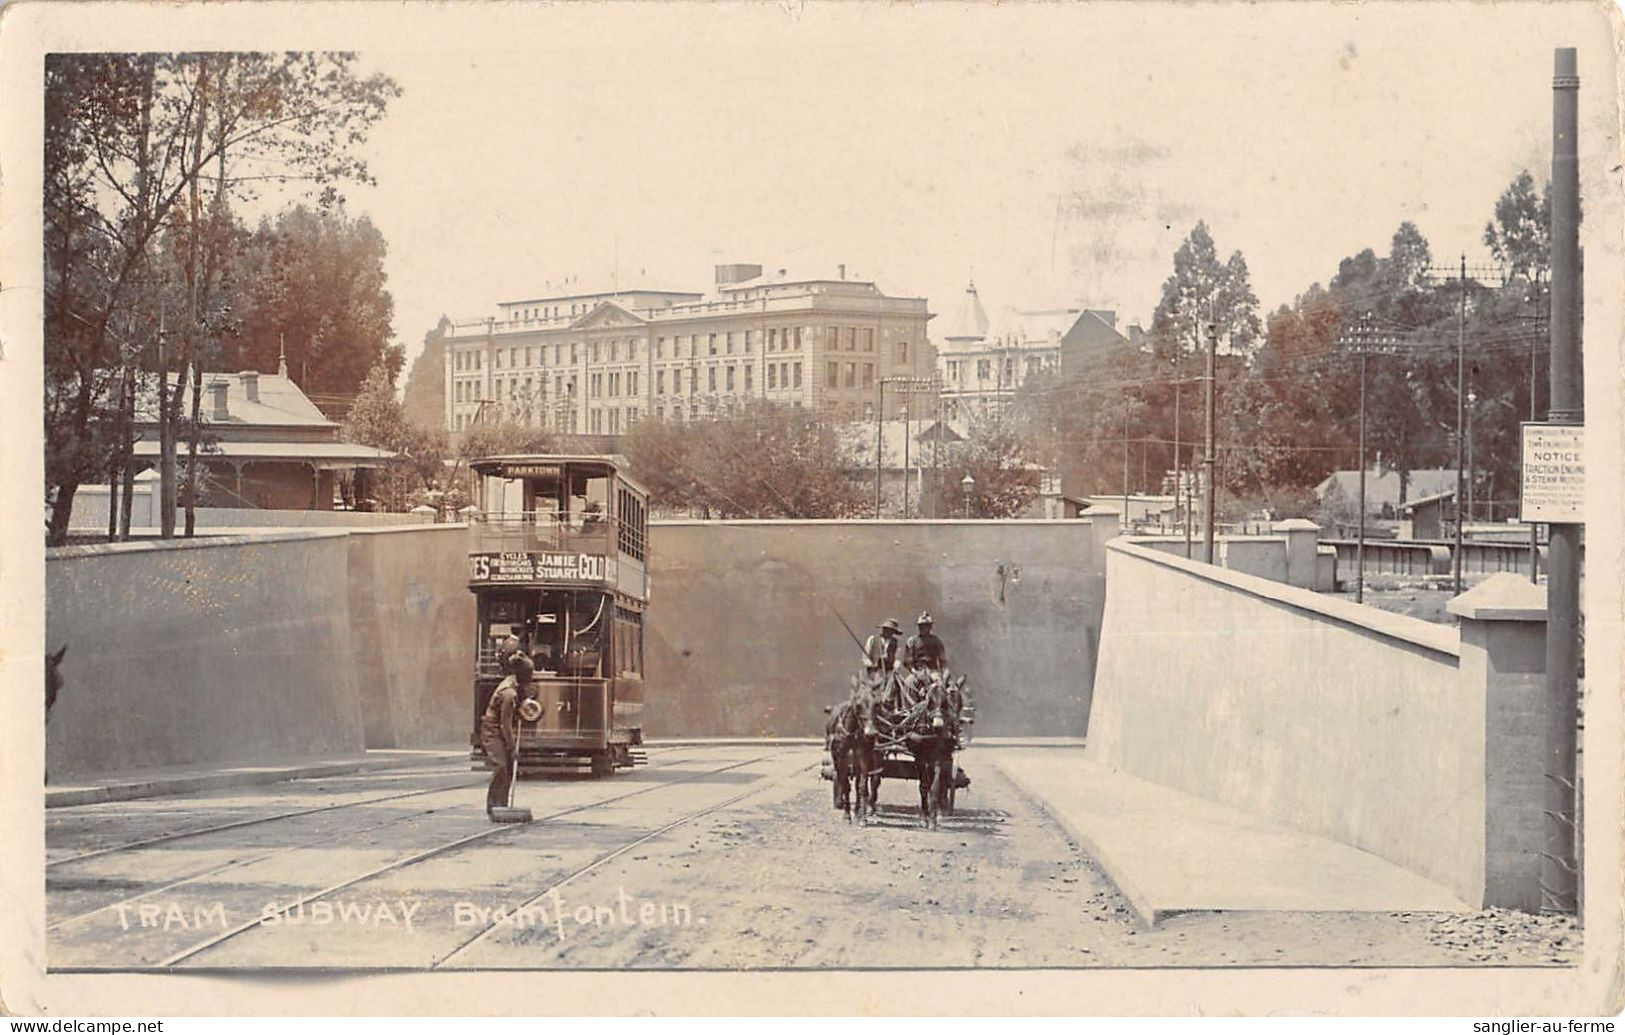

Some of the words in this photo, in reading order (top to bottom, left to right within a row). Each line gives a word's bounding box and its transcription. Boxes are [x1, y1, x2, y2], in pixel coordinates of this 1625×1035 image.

[1534, 452, 1581, 461] NOTICE
[507, 466, 560, 475] PARKTOWN
[1525, 464, 1559, 474] TRACTION
[1532, 475, 1557, 484] STEAM
[500, 552, 528, 560] CYCLES
[537, 553, 576, 567] JAMIE
[579, 553, 605, 580] GOLD
[536, 566, 579, 579] STUART
[555, 700, 571, 712] 71
[113, 901, 228, 931] TRAM
[260, 894, 420, 934] SUBWAY
